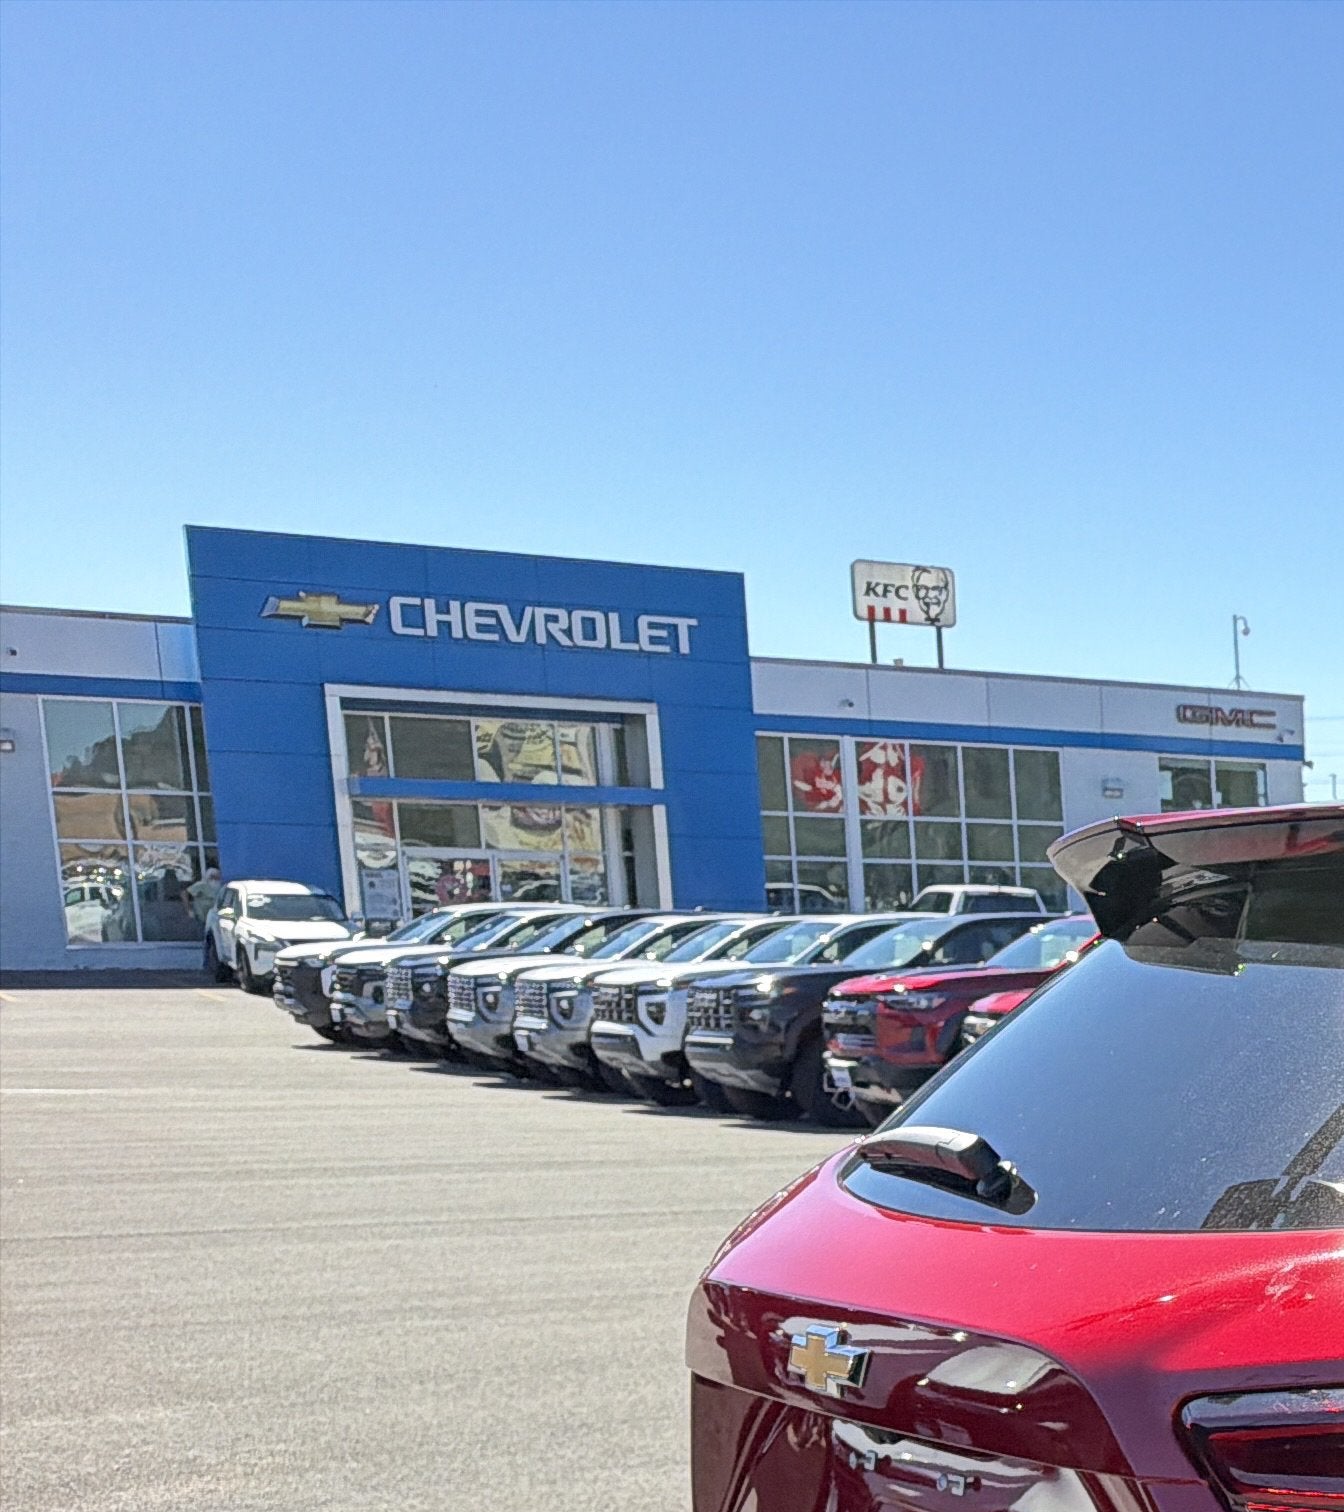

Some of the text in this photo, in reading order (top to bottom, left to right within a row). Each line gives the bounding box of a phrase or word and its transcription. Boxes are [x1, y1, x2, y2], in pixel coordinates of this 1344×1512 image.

[863, 580, 909, 601] KFC
[389, 595, 699, 655] CHEVROLET
[1176, 704, 1277, 731] GMC
